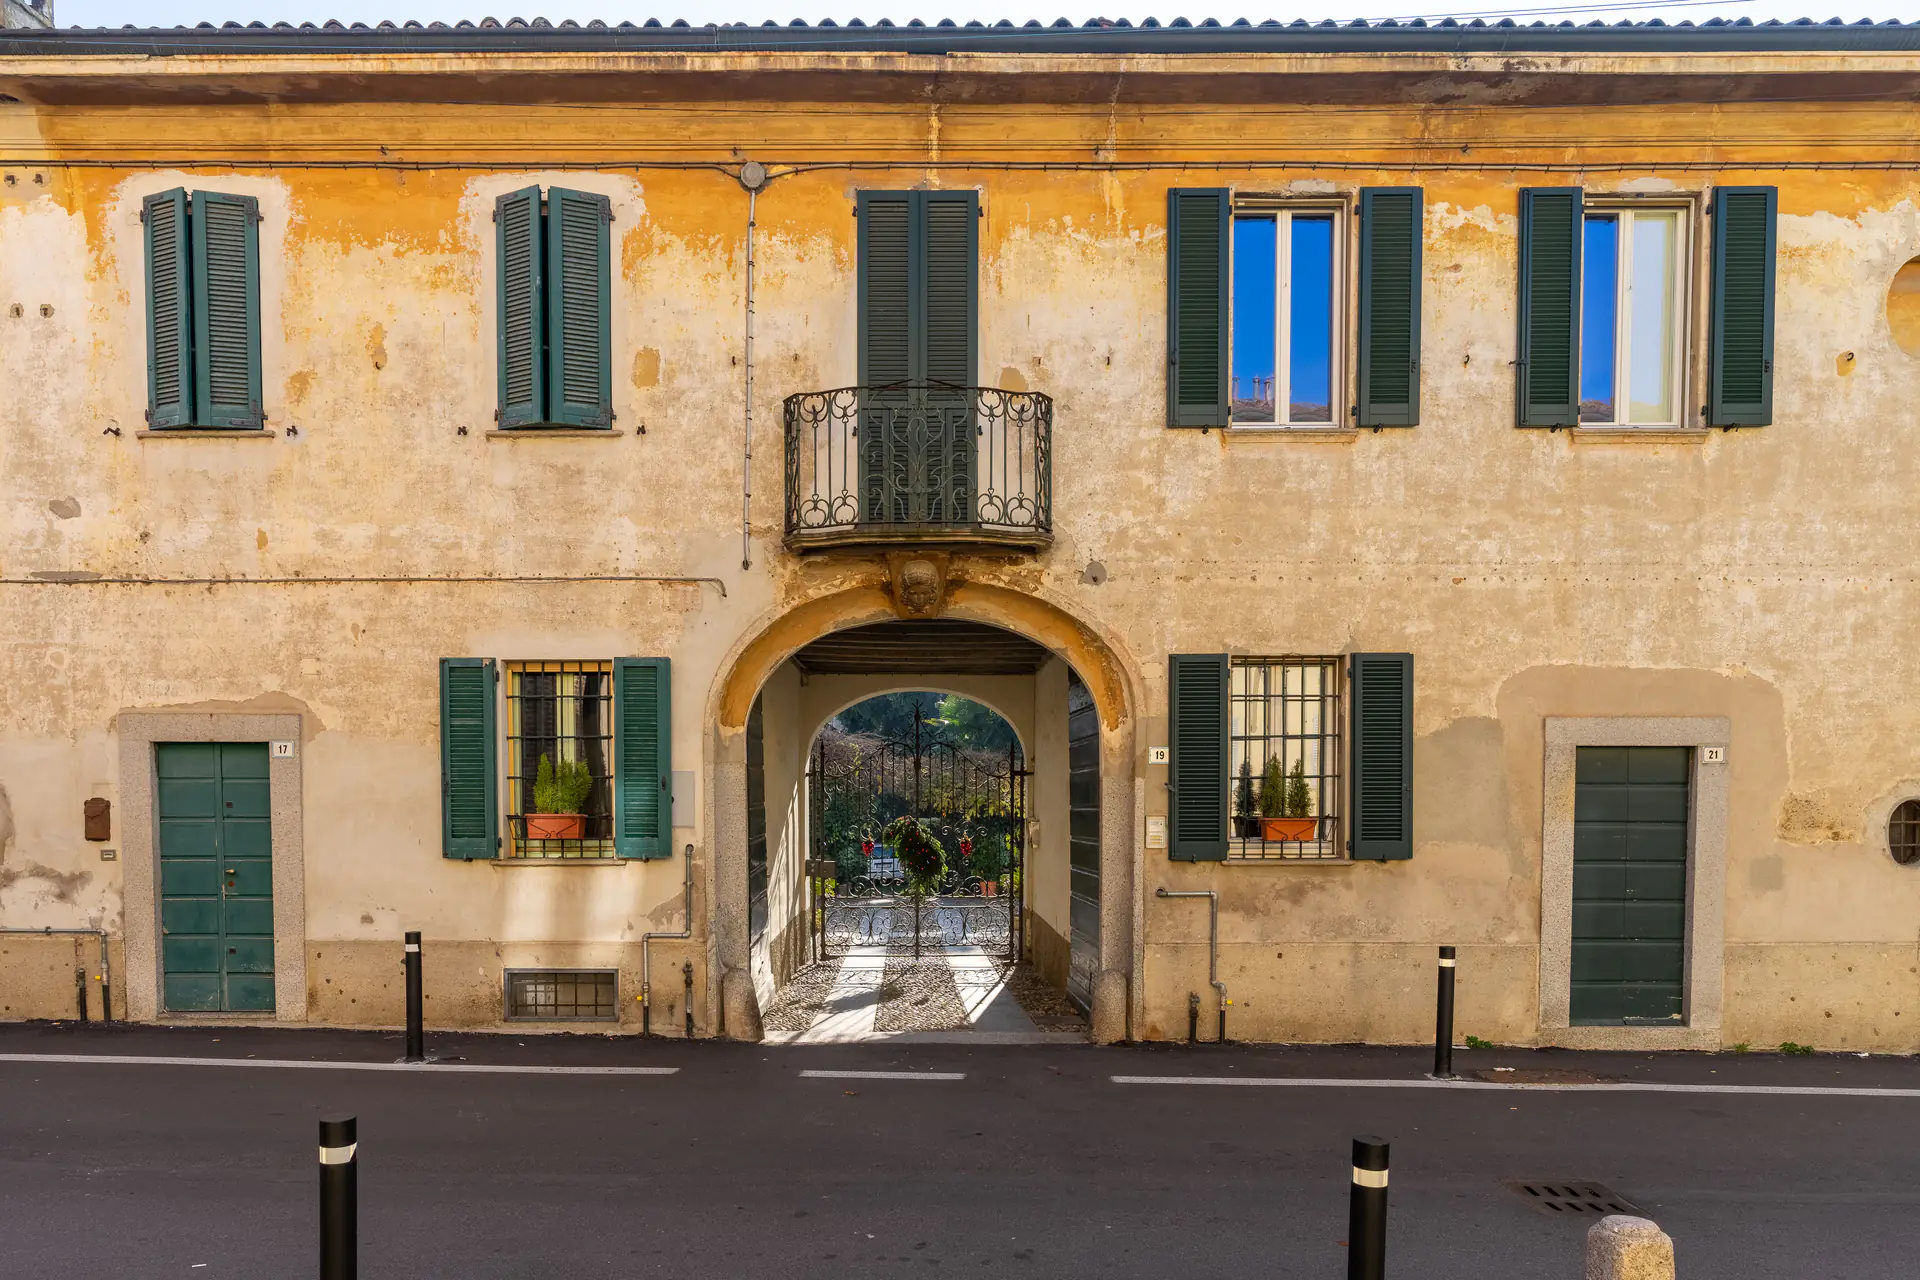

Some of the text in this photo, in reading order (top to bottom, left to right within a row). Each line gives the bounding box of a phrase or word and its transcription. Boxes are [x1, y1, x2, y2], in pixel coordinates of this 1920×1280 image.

[278, 744, 288, 754] 17
[1155, 750, 1165, 760] 19
[1708, 750, 1718, 760] 21
